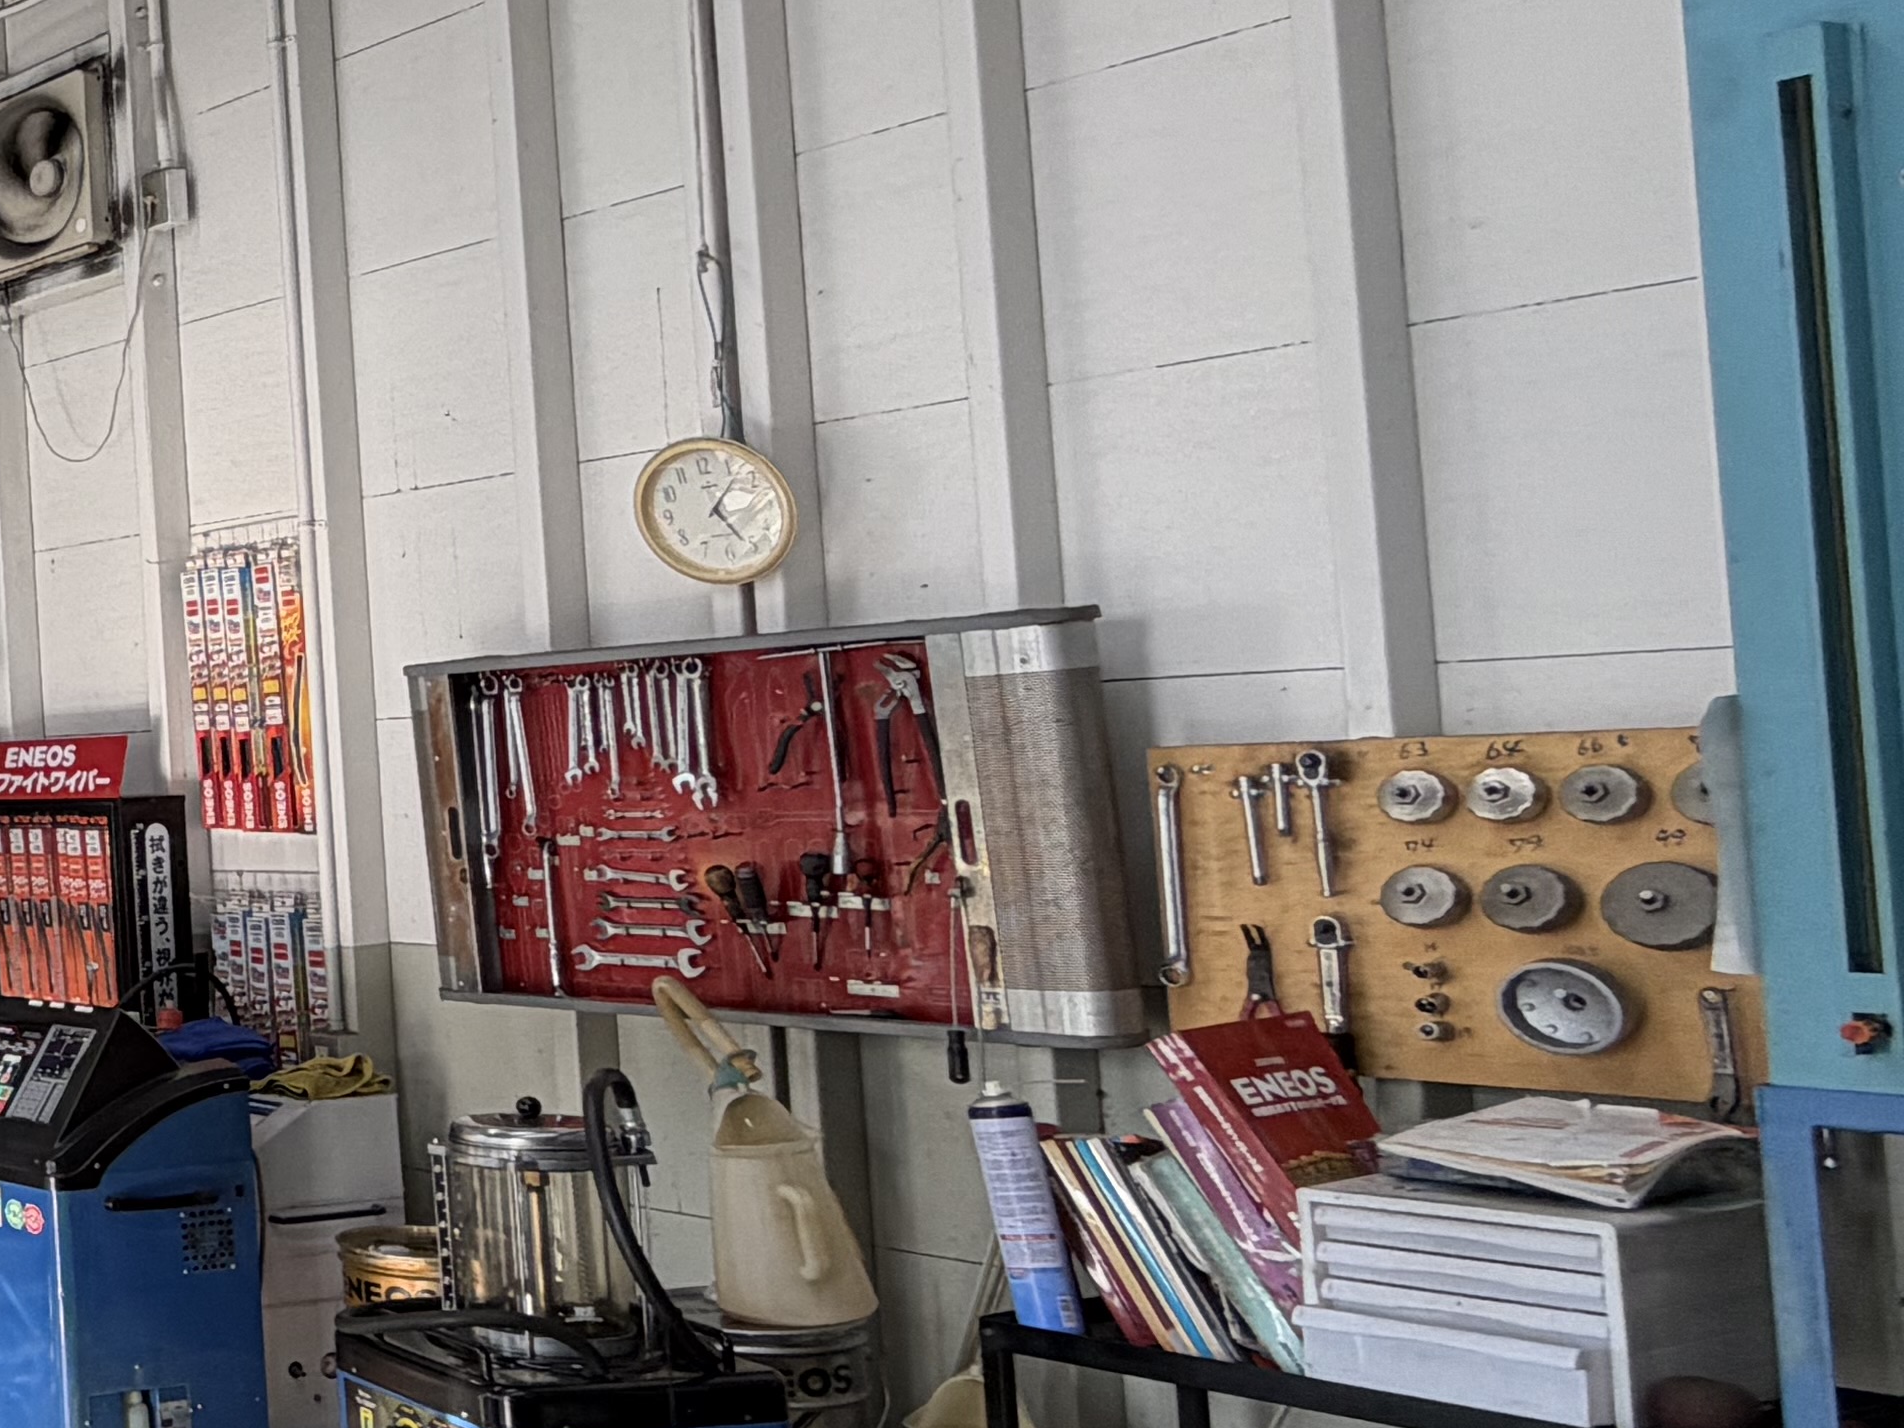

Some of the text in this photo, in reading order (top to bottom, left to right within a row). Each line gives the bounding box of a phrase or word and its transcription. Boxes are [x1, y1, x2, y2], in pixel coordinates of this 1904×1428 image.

[696, 457, 712, 475] 12
[675, 467, 688, 484] 11
[663, 485, 676, 503] 10
[663, 509, 674, 526] 9
[677, 529, 689, 547] 8
[700, 541, 709, 558] 7
[4, 744, 76, 769] ENEOS
[1230, 1066, 1337, 1106] ENEOS
[344, 1276, 437, 1303] NEO
